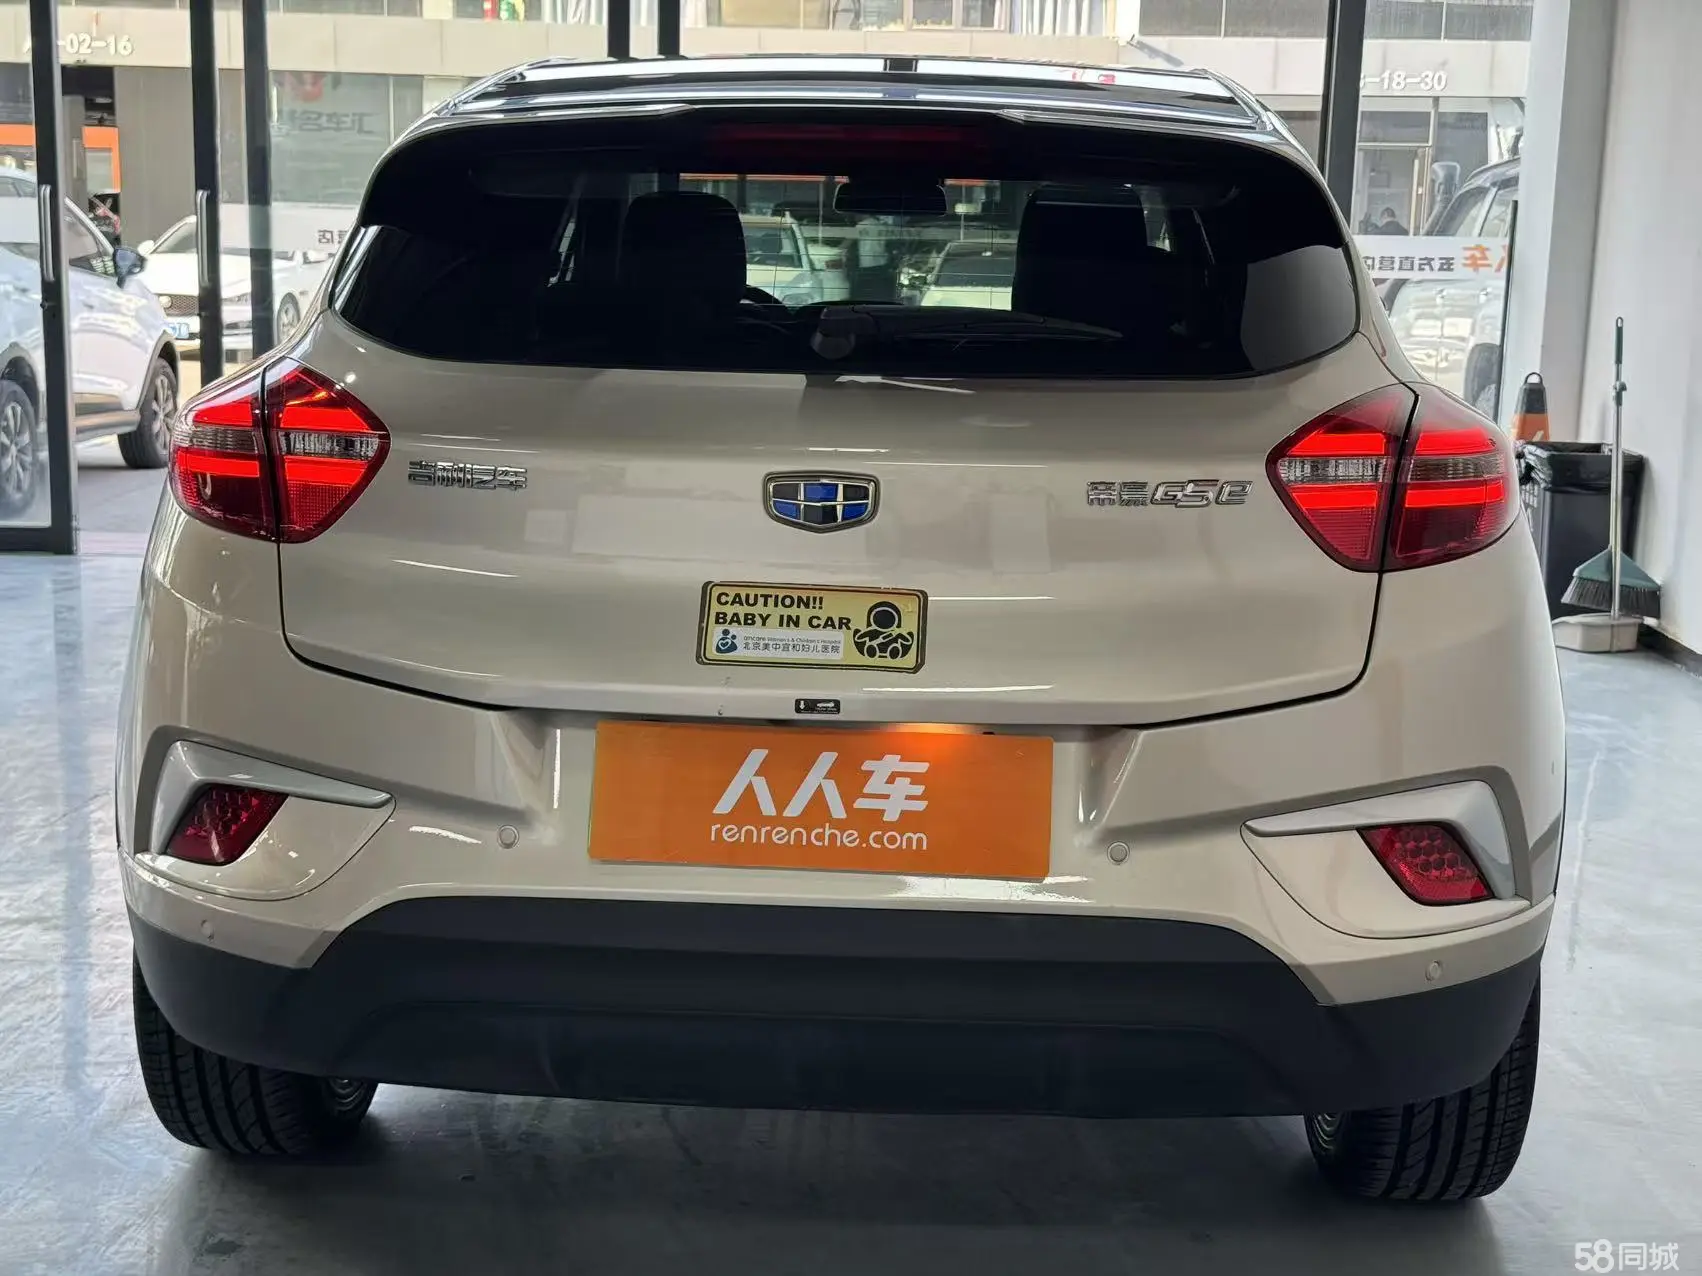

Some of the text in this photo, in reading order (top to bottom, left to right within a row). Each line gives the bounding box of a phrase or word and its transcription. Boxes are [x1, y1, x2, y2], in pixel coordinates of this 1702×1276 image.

[24, 32, 134, 56] -02-16
[716, 592, 824, 609] CAUTION!!
[714, 611, 852, 630] BABY IN CAR
[743, 642, 841, 654] 北京美中宜和妇儿医院
[712, 749, 930, 822] 人人车
[711, 823, 928, 850] renrenche.com
